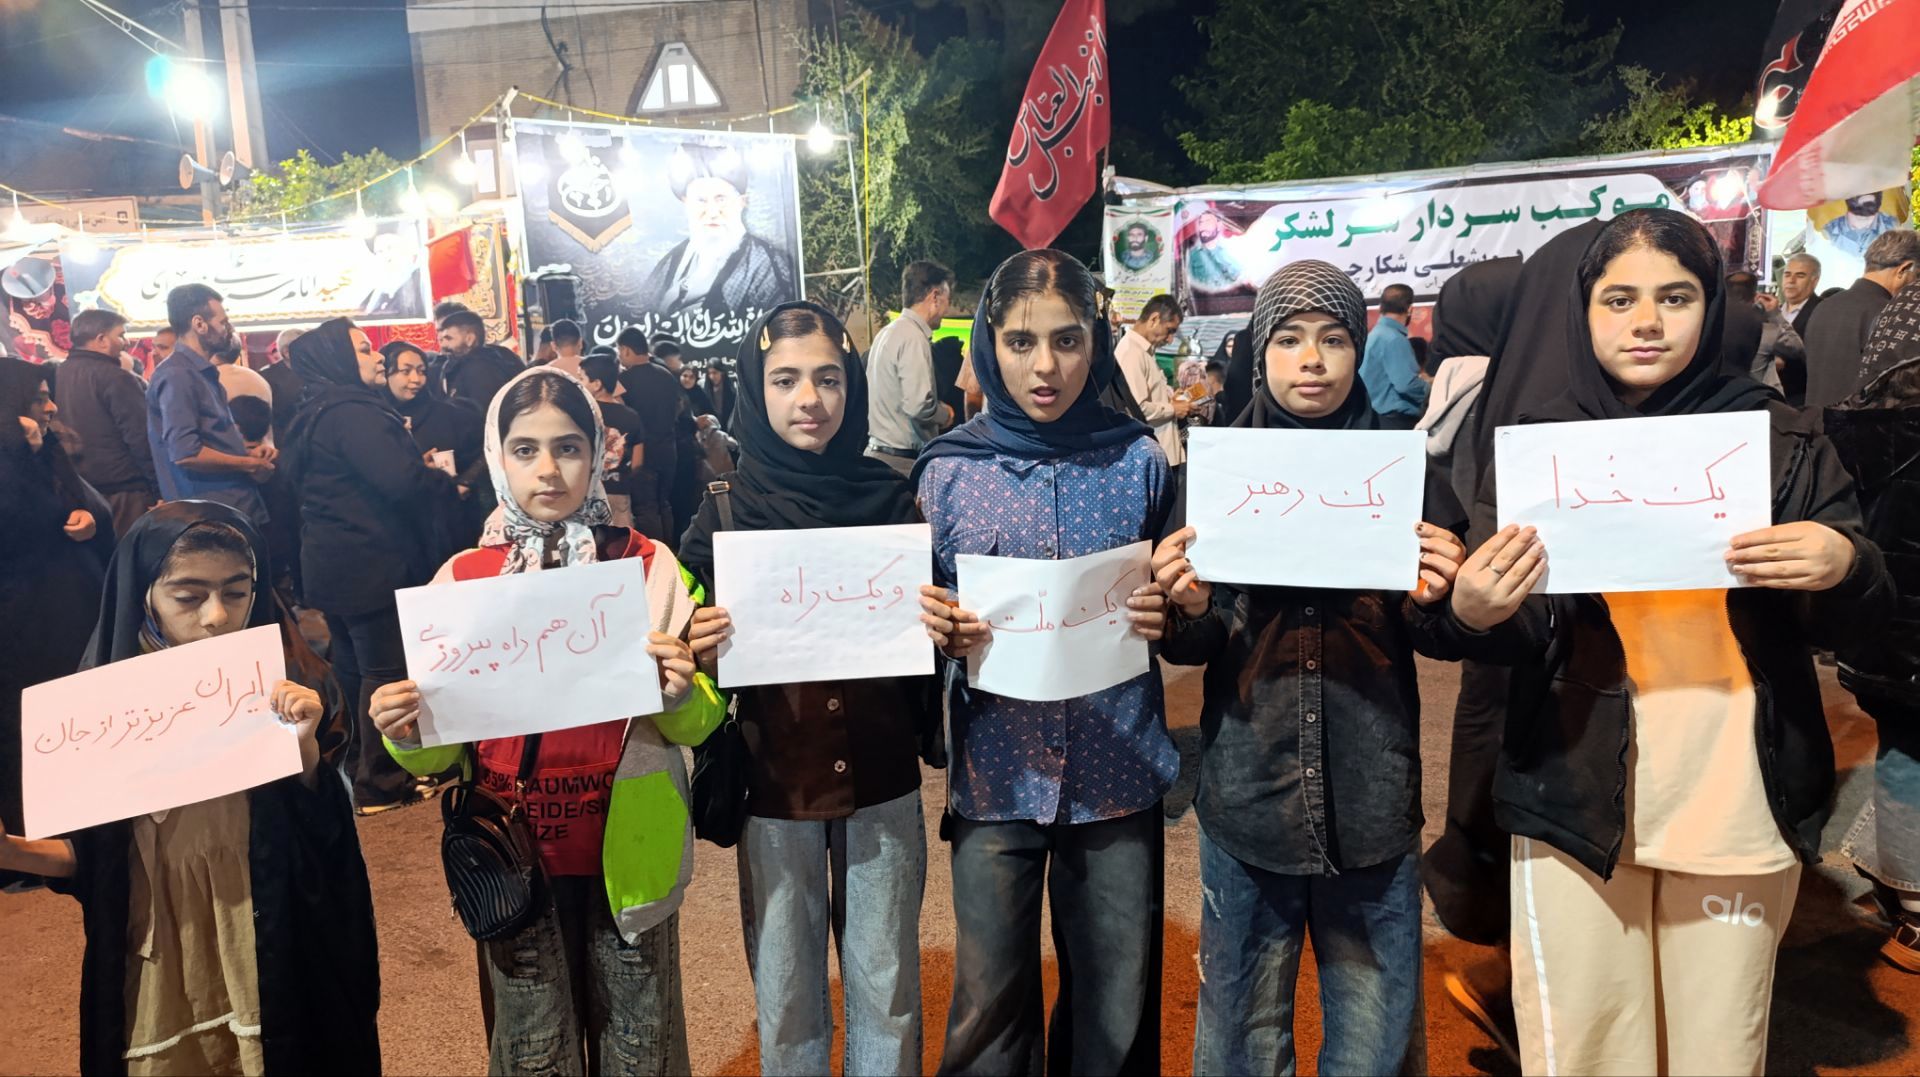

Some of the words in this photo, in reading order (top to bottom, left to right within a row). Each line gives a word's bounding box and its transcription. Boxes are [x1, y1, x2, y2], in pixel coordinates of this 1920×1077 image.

[1408, 198, 1521, 242] سردار
[1531, 184, 1670, 230] موکب
[1344, 254, 1408, 283] شکارچ
[1227, 481, 1305, 517] رهبر
[1319, 456, 1406, 519] یک
[1643, 442, 1748, 519] یک
[780, 566, 821, 623] راه
[1062, 567, 1137, 627] یک
[566, 584, 625, 655] آن
[502, 626, 529, 665] راه
[537, 618, 568, 673] هم
[195, 660, 265, 727] ایران
[34, 717, 91, 754] جان
[92, 714, 113, 744] از
[515, 771, 615, 795] AUMWO
[530, 824, 569, 841] IZE
[1702, 892, 1765, 927] alo
